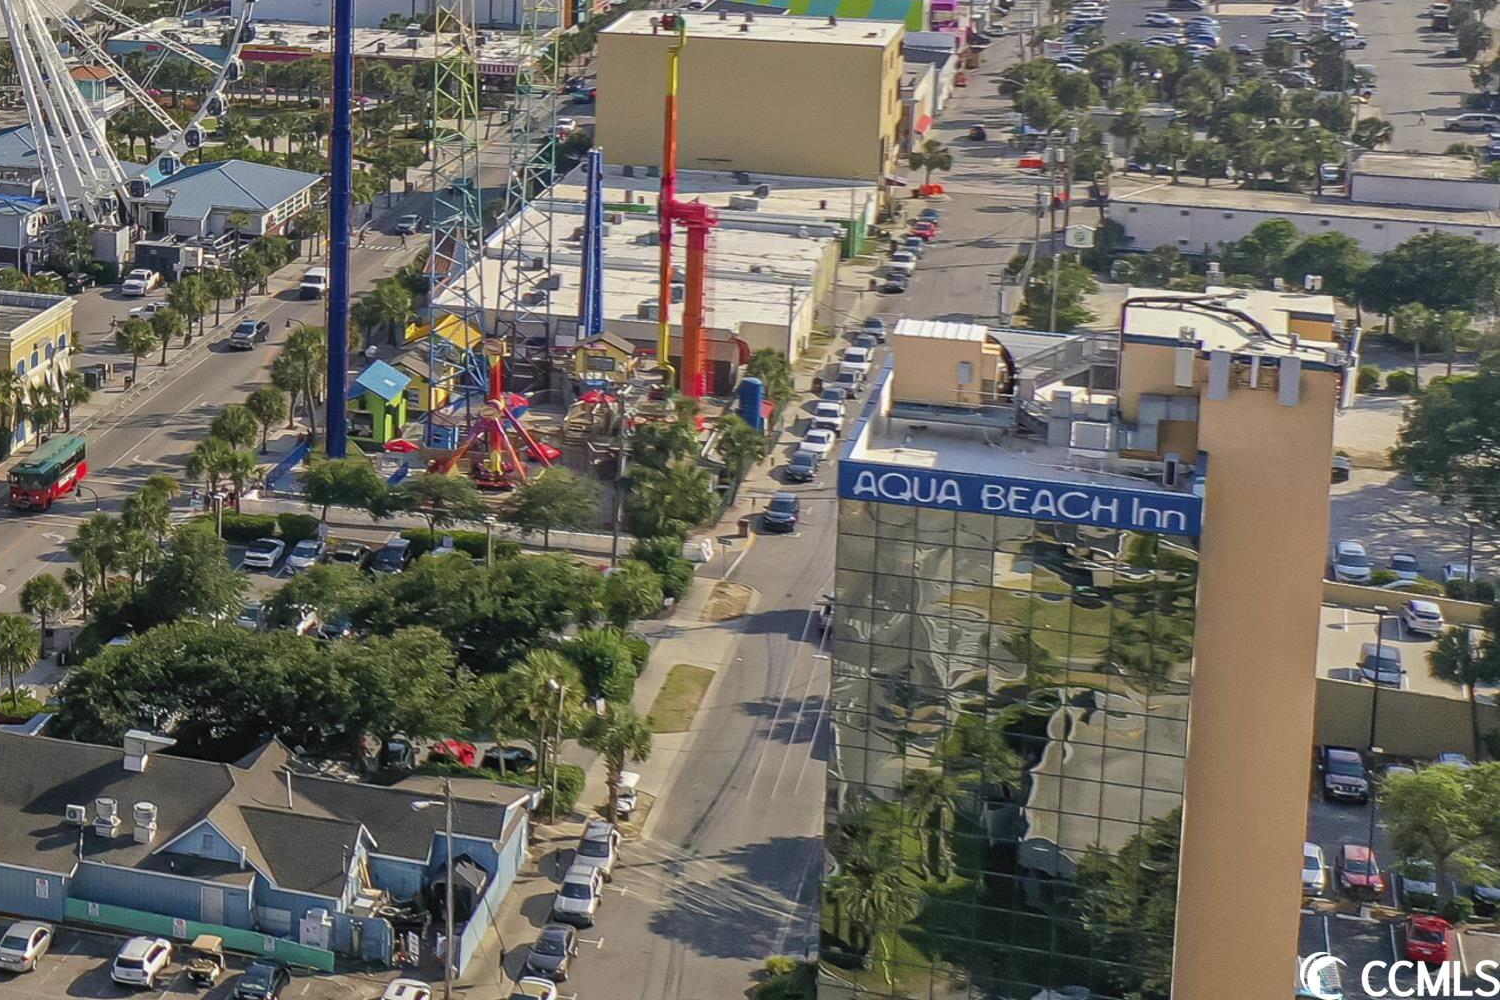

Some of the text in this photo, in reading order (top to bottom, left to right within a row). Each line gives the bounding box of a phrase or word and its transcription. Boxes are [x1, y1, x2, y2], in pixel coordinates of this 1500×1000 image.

[852, 470, 1187, 531] AQUA BEACH Inn
